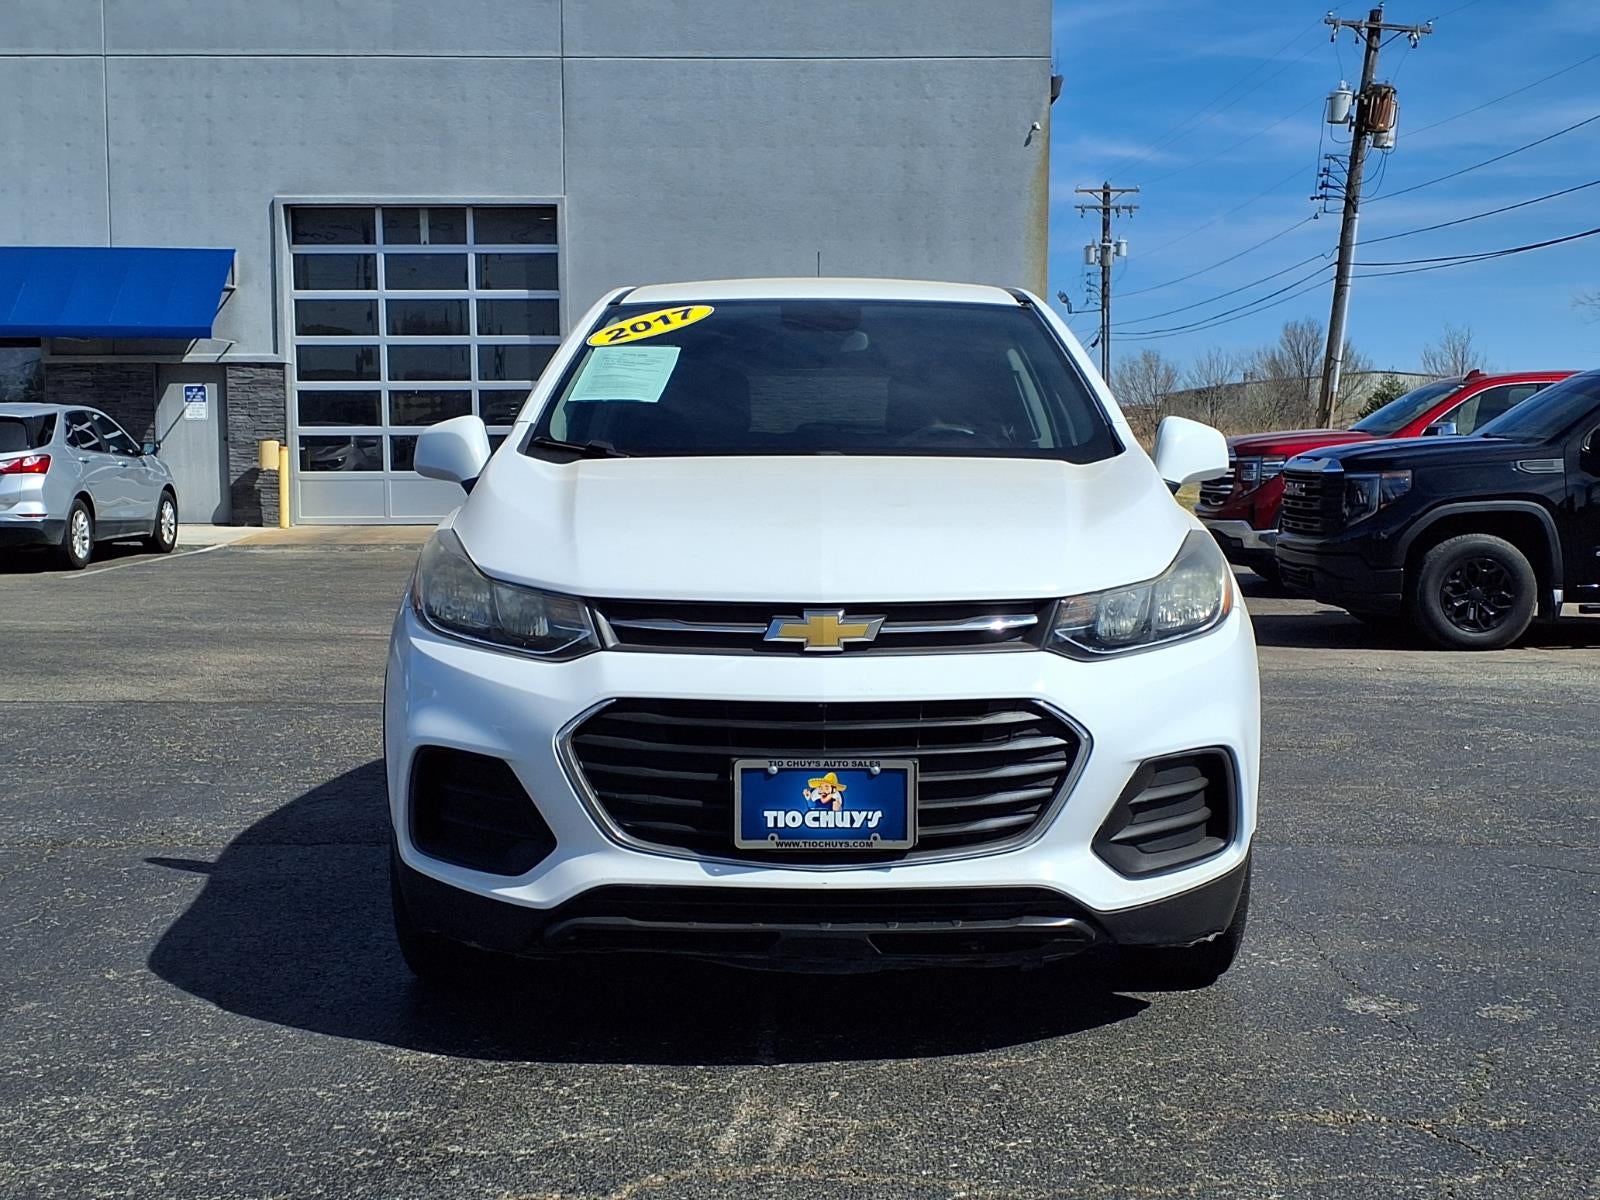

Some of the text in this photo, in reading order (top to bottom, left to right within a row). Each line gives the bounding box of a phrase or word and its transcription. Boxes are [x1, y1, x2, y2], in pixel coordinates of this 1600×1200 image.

[605, 308, 693, 342] 2017
[763, 810, 883, 828] TIO CHUY'S
